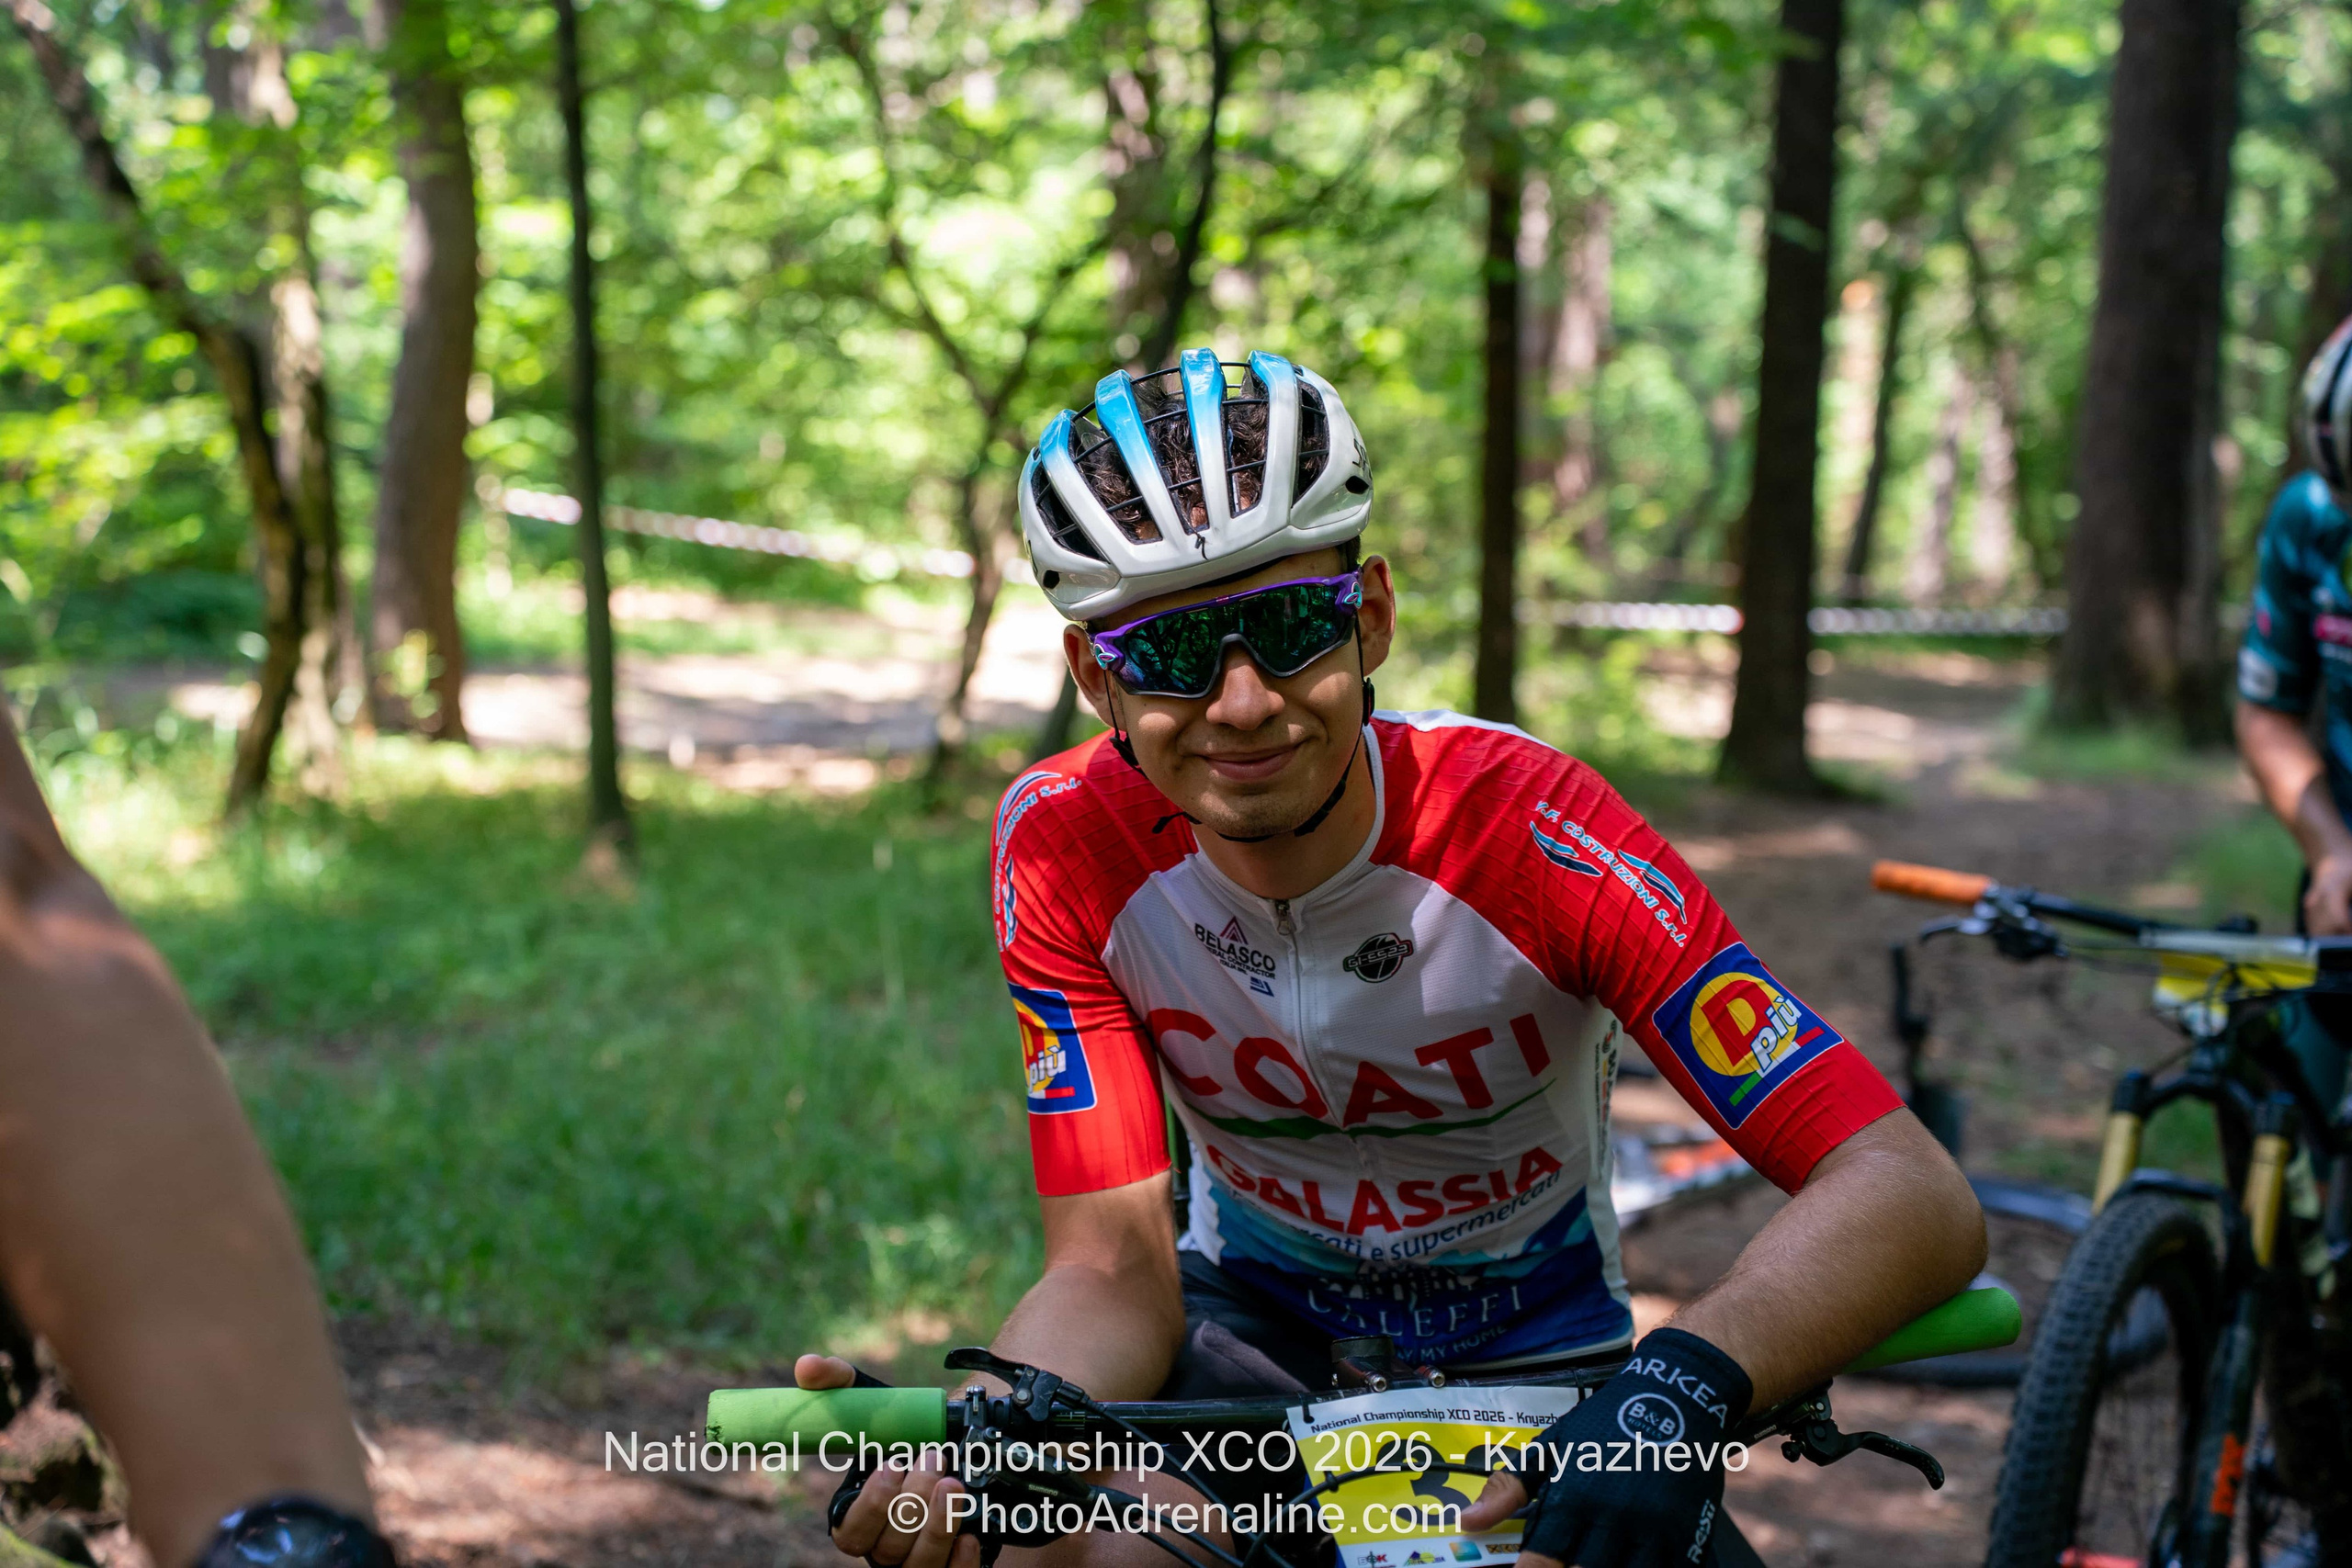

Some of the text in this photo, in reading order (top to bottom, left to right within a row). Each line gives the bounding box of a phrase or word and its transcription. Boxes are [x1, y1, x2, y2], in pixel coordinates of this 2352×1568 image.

[1562, 820, 1658, 909] COSTRUZIONI
[1655, 907, 1688, 948] S.r.l.
[1195, 923, 1276, 972] BELASCO
[1227, 957, 1276, 980] CONTRACTOR
[1146, 1008, 1551, 1128] COATI
[1208, 1145, 1563, 1236] GALASSIA
[1390, 1169, 1561, 1261] supermercati
[1311, 1415, 1361, 1434] National
[1363, 1408, 1445, 1422] Championship
[1447, 1408, 1470, 1421] XCO
[1474, 1410, 1505, 1423] 2026
[1517, 1412, 1559, 1427] Knyazh
[1620, 1357, 1729, 1429] ARKEA
